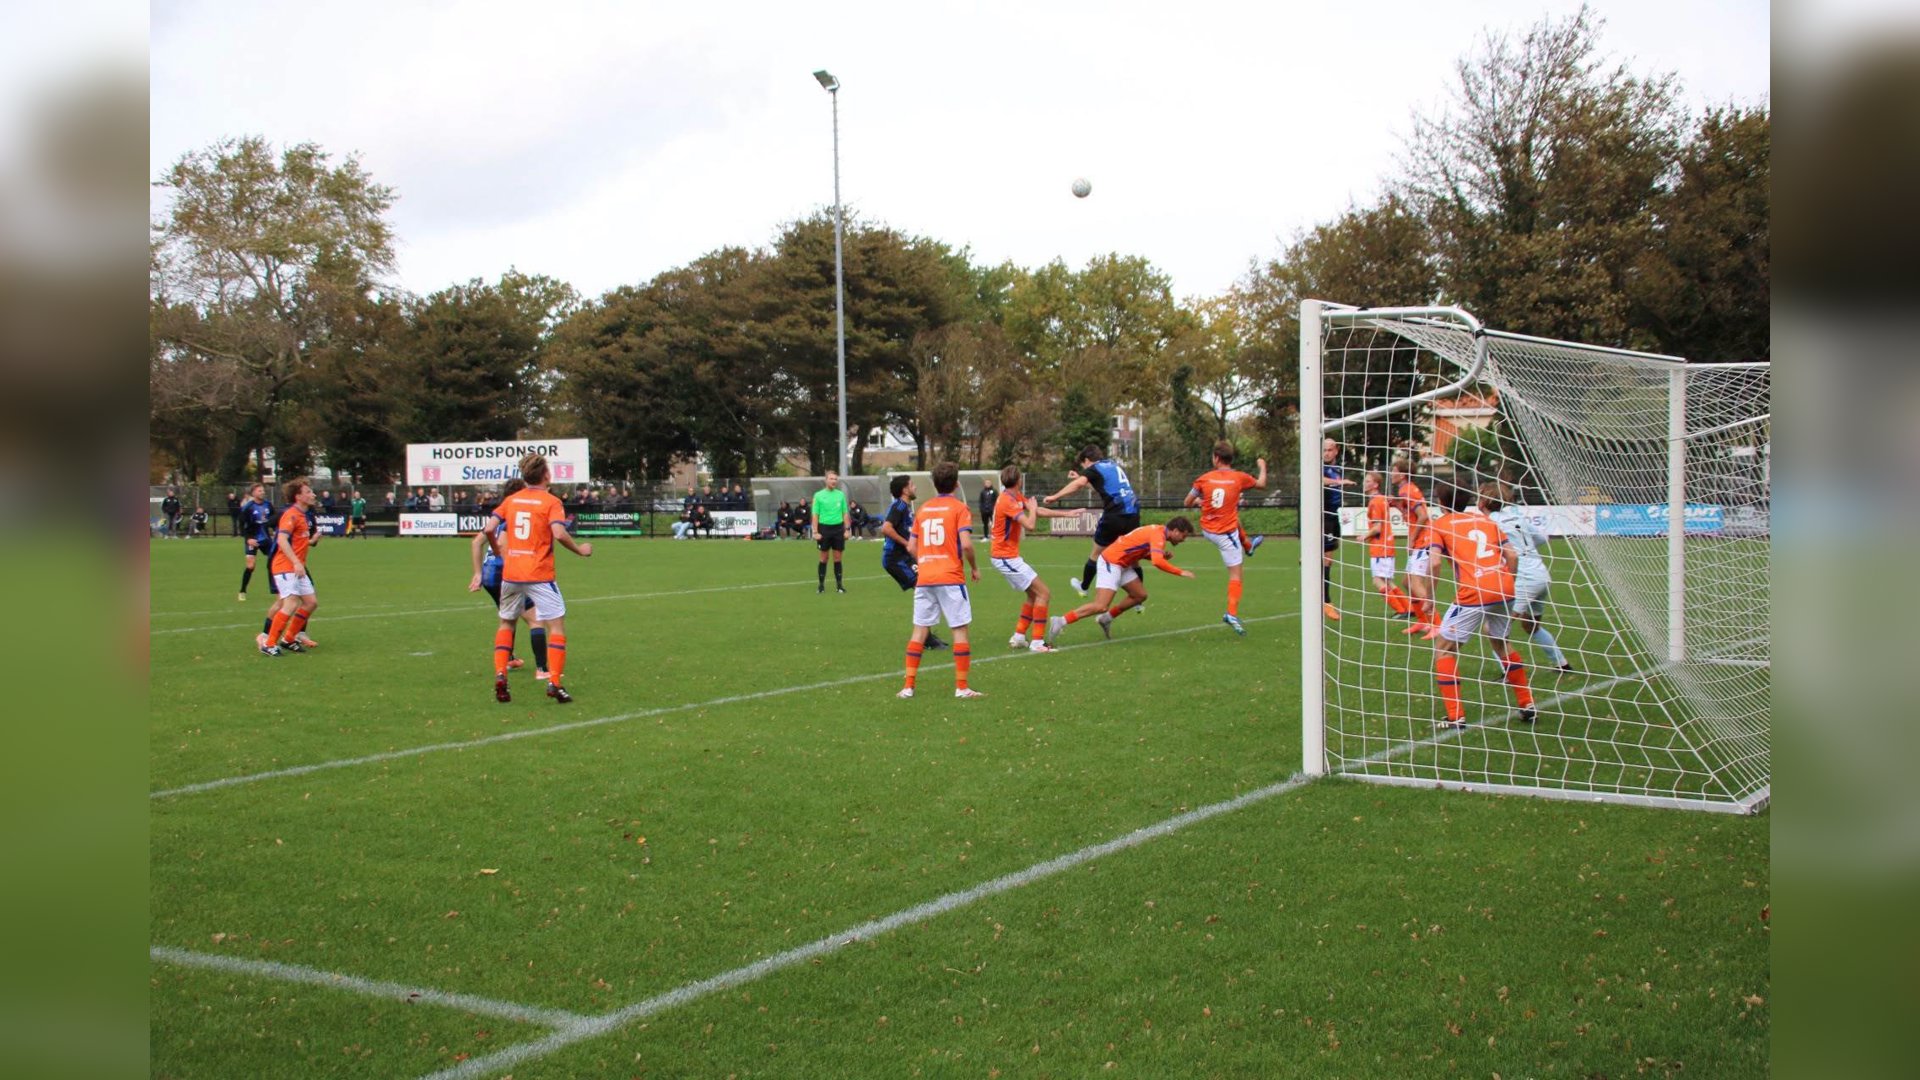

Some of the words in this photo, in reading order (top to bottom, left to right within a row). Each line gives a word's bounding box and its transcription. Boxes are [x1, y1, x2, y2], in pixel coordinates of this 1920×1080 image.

[433, 445, 559, 459] HOOFDSPONSOR
[462, 465, 501, 480] Stena
[1116, 466, 1130, 487] 4
[1211, 488, 1225, 508] 9
[414, 520, 438, 529] Stena
[514, 511, 531, 540] 5
[921, 518, 945, 546] 15
[1468, 529, 1495, 559] 2
